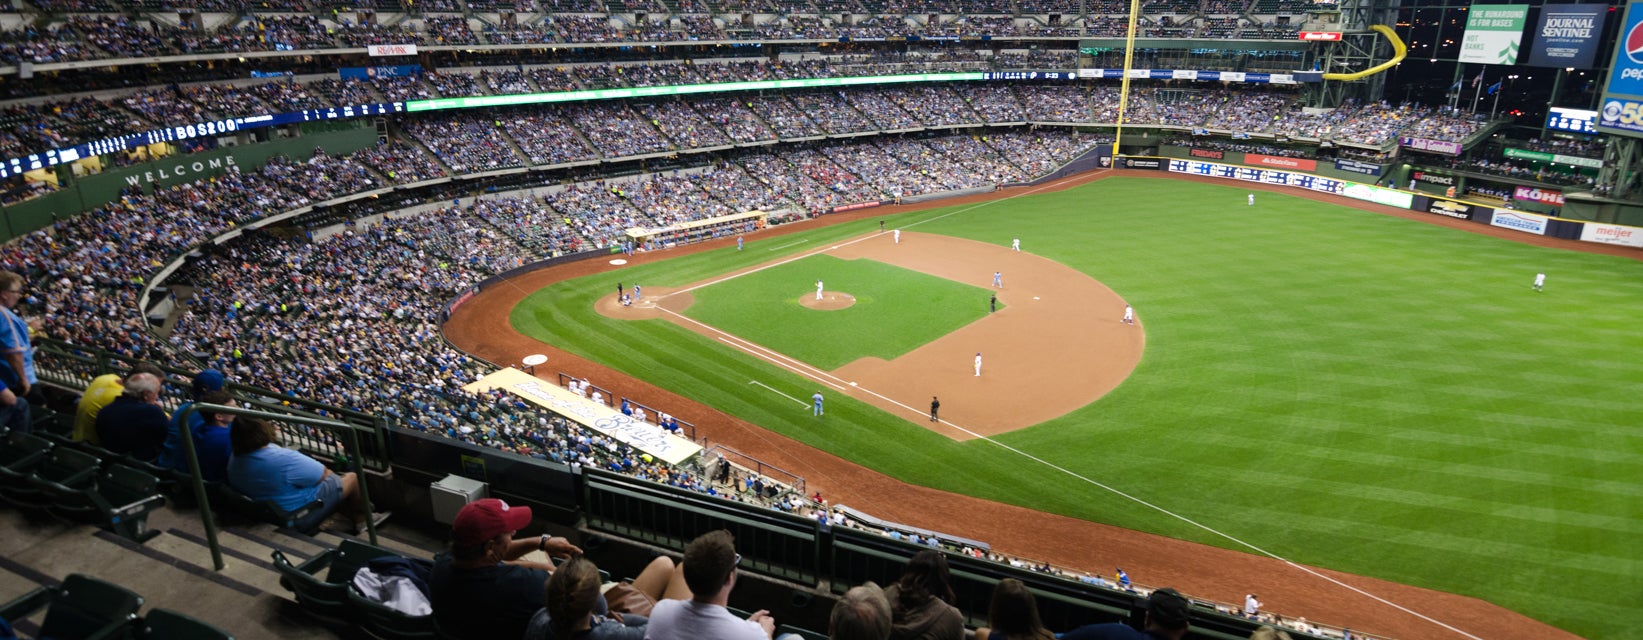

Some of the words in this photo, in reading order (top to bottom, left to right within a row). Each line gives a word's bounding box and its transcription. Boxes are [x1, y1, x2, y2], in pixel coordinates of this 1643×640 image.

[1544, 19, 1594, 28] JOURNAL
[1542, 28, 1592, 38] SENTINEL
[377, 66, 398, 75] PNC
[1191, 149, 1222, 159] FRIDAYS
[125, 155, 235, 186] WELCOME
[1430, 208, 1468, 219] CHEVROLET
[1596, 227, 1632, 238] meijer
